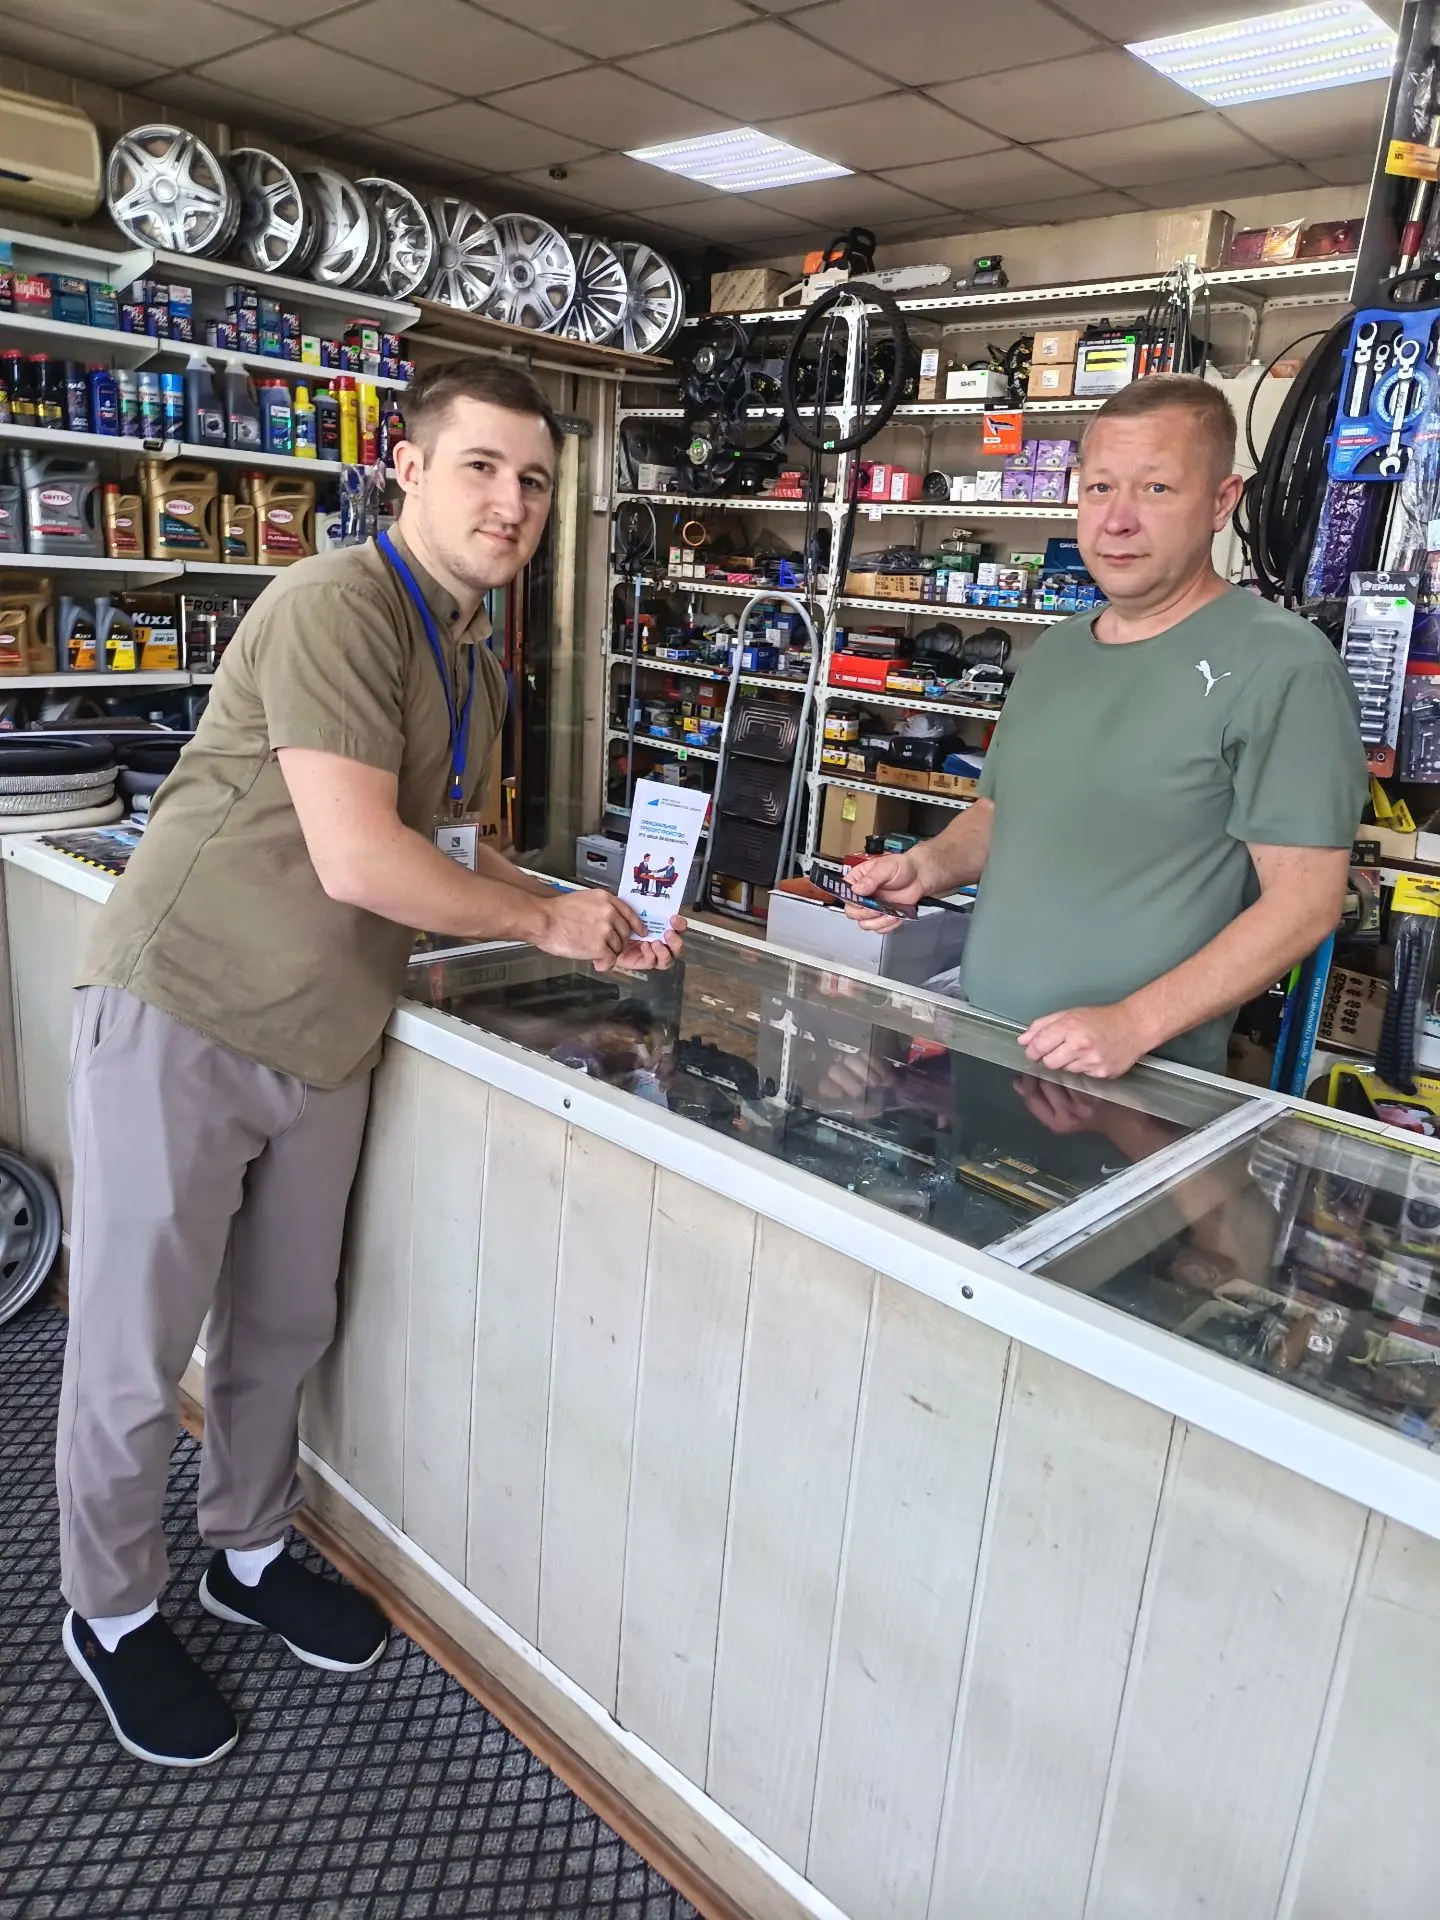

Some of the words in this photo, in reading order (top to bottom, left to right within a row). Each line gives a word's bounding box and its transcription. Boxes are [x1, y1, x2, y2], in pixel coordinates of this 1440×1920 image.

[42, 492, 71, 502] SINTEC
[193, 600, 229, 611] ROLF
[131, 612, 173, 625] Kixx
